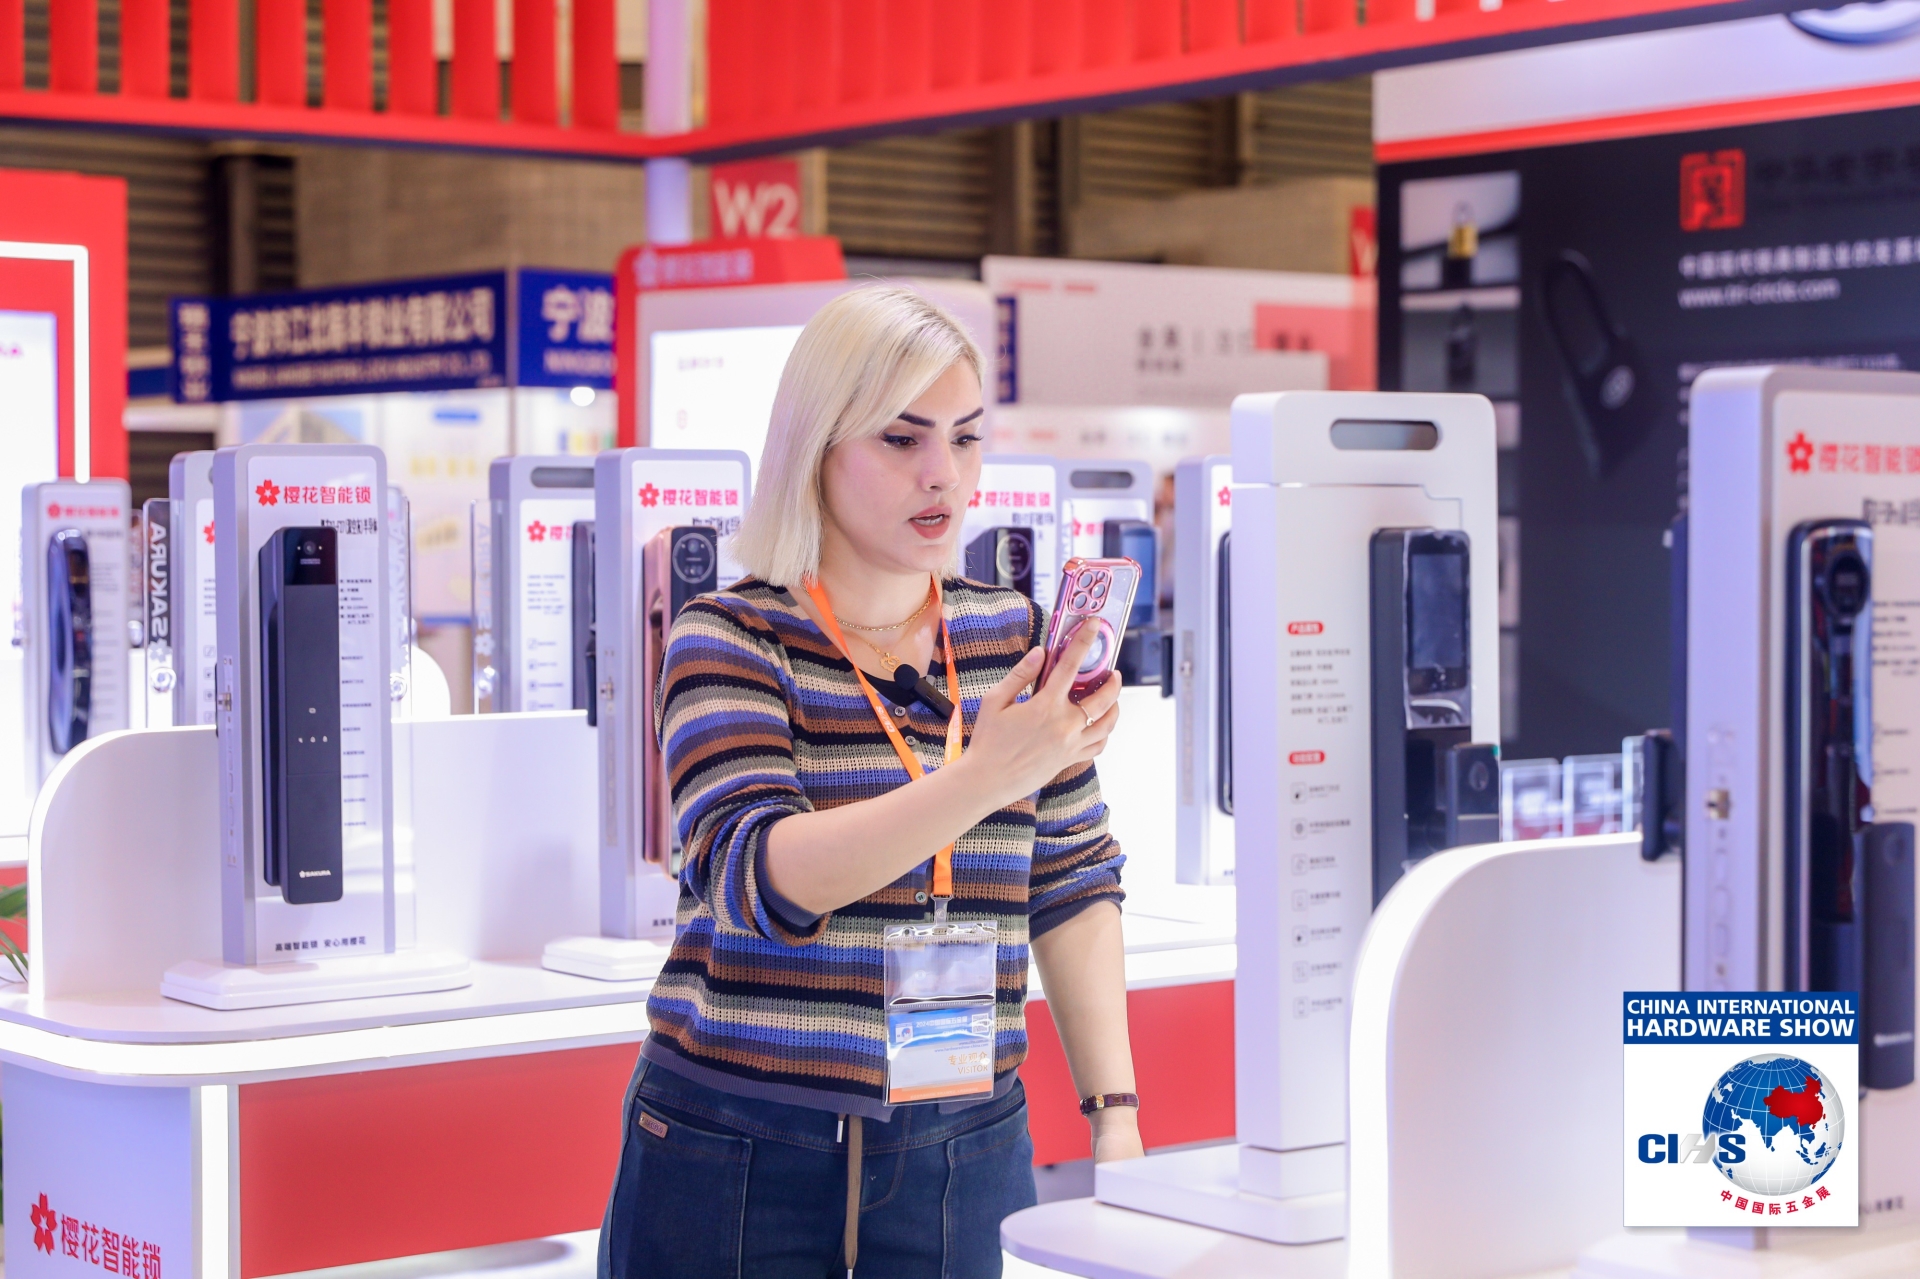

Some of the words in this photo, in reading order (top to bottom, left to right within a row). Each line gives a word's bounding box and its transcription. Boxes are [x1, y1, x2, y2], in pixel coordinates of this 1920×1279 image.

[713, 180, 798, 239] W2
[1679, 236, 1920, 281] 中国现代锁具制造业的发源
[283, 486, 371, 505] 樱花智能锁
[662, 488, 739, 507] 樱花智能锁
[985, 491, 1051, 508] 樱花智能锁
[275, 940, 318, 952] 高端智能锁
[324, 936, 366, 948] 安心用樱花
[61, 1213, 162, 1279] 樱花智能锁
